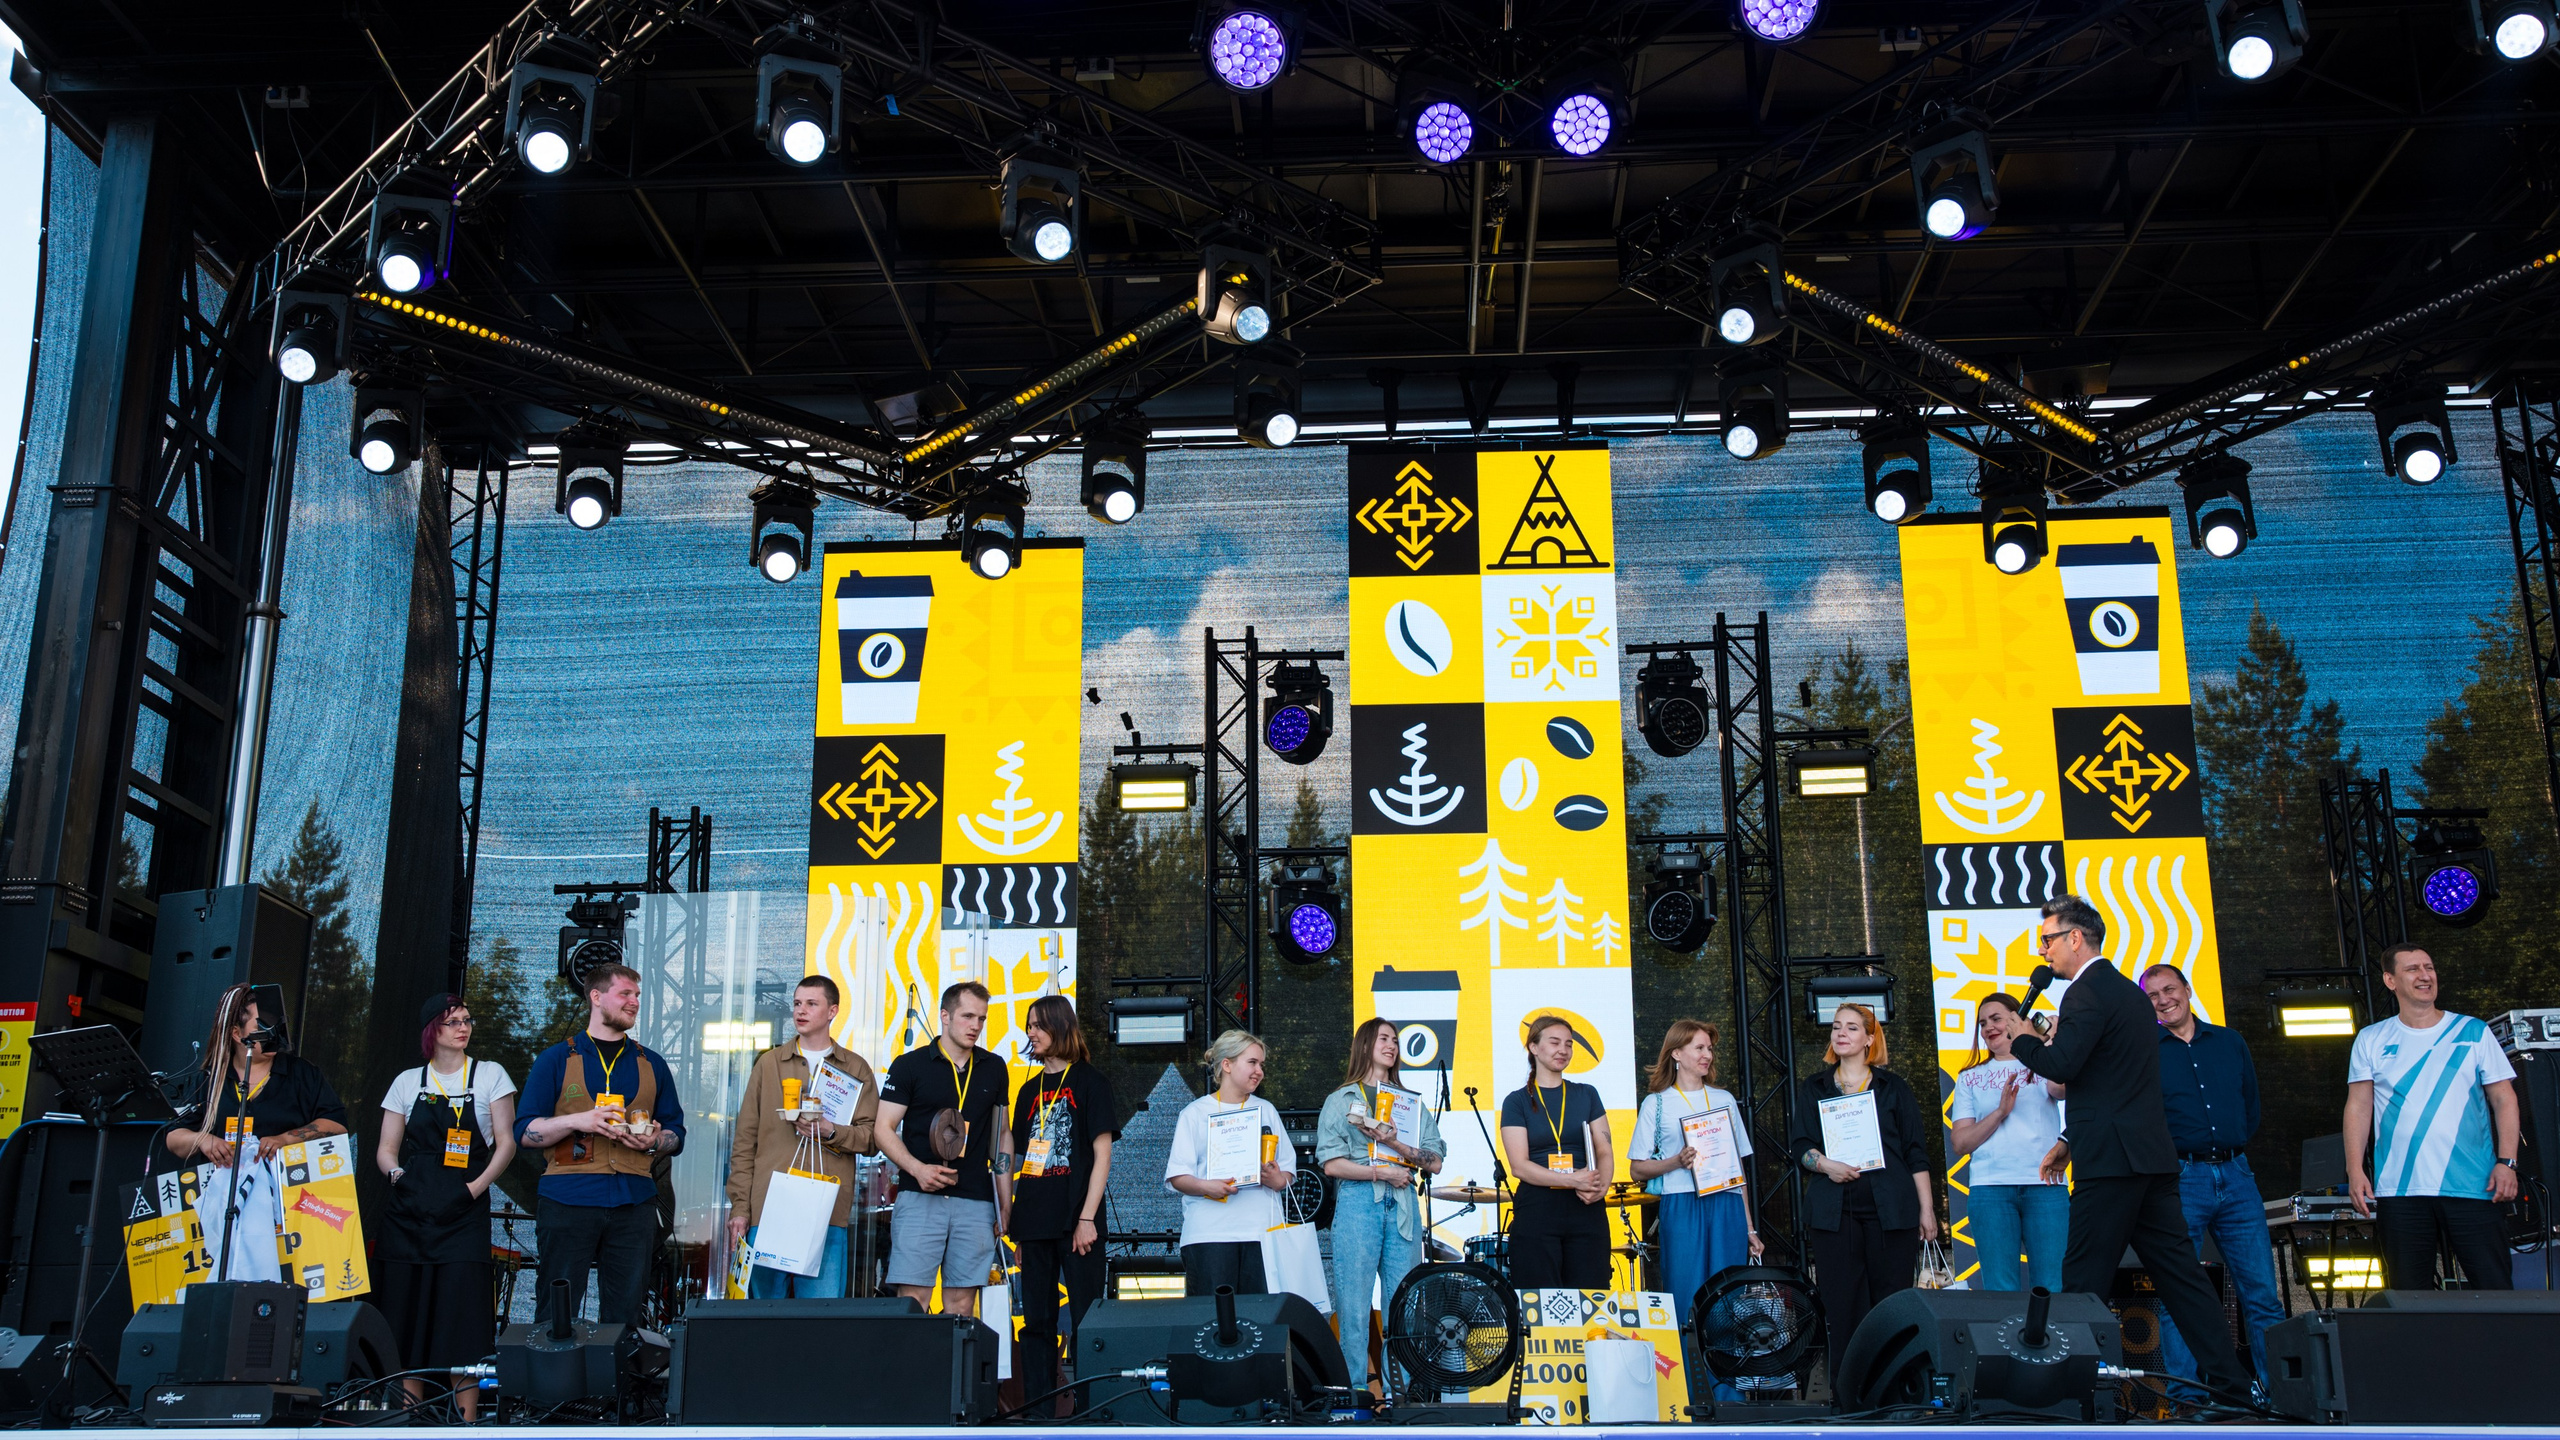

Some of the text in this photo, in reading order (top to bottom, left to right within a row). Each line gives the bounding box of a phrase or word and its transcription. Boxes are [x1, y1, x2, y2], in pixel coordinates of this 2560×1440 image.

[1835, 1109, 1863, 1120] ДИПЛОМ
[1221, 1125, 1248, 1135] ДИПЛОМ
[1696, 1127, 1722, 1138] ДИПЛОМ
[301, 1198, 343, 1222] Альфа Банк
[131, 1231, 171, 1247] ЧЕРНОЕ
[1527, 1339, 1586, 1354] III МЕ
